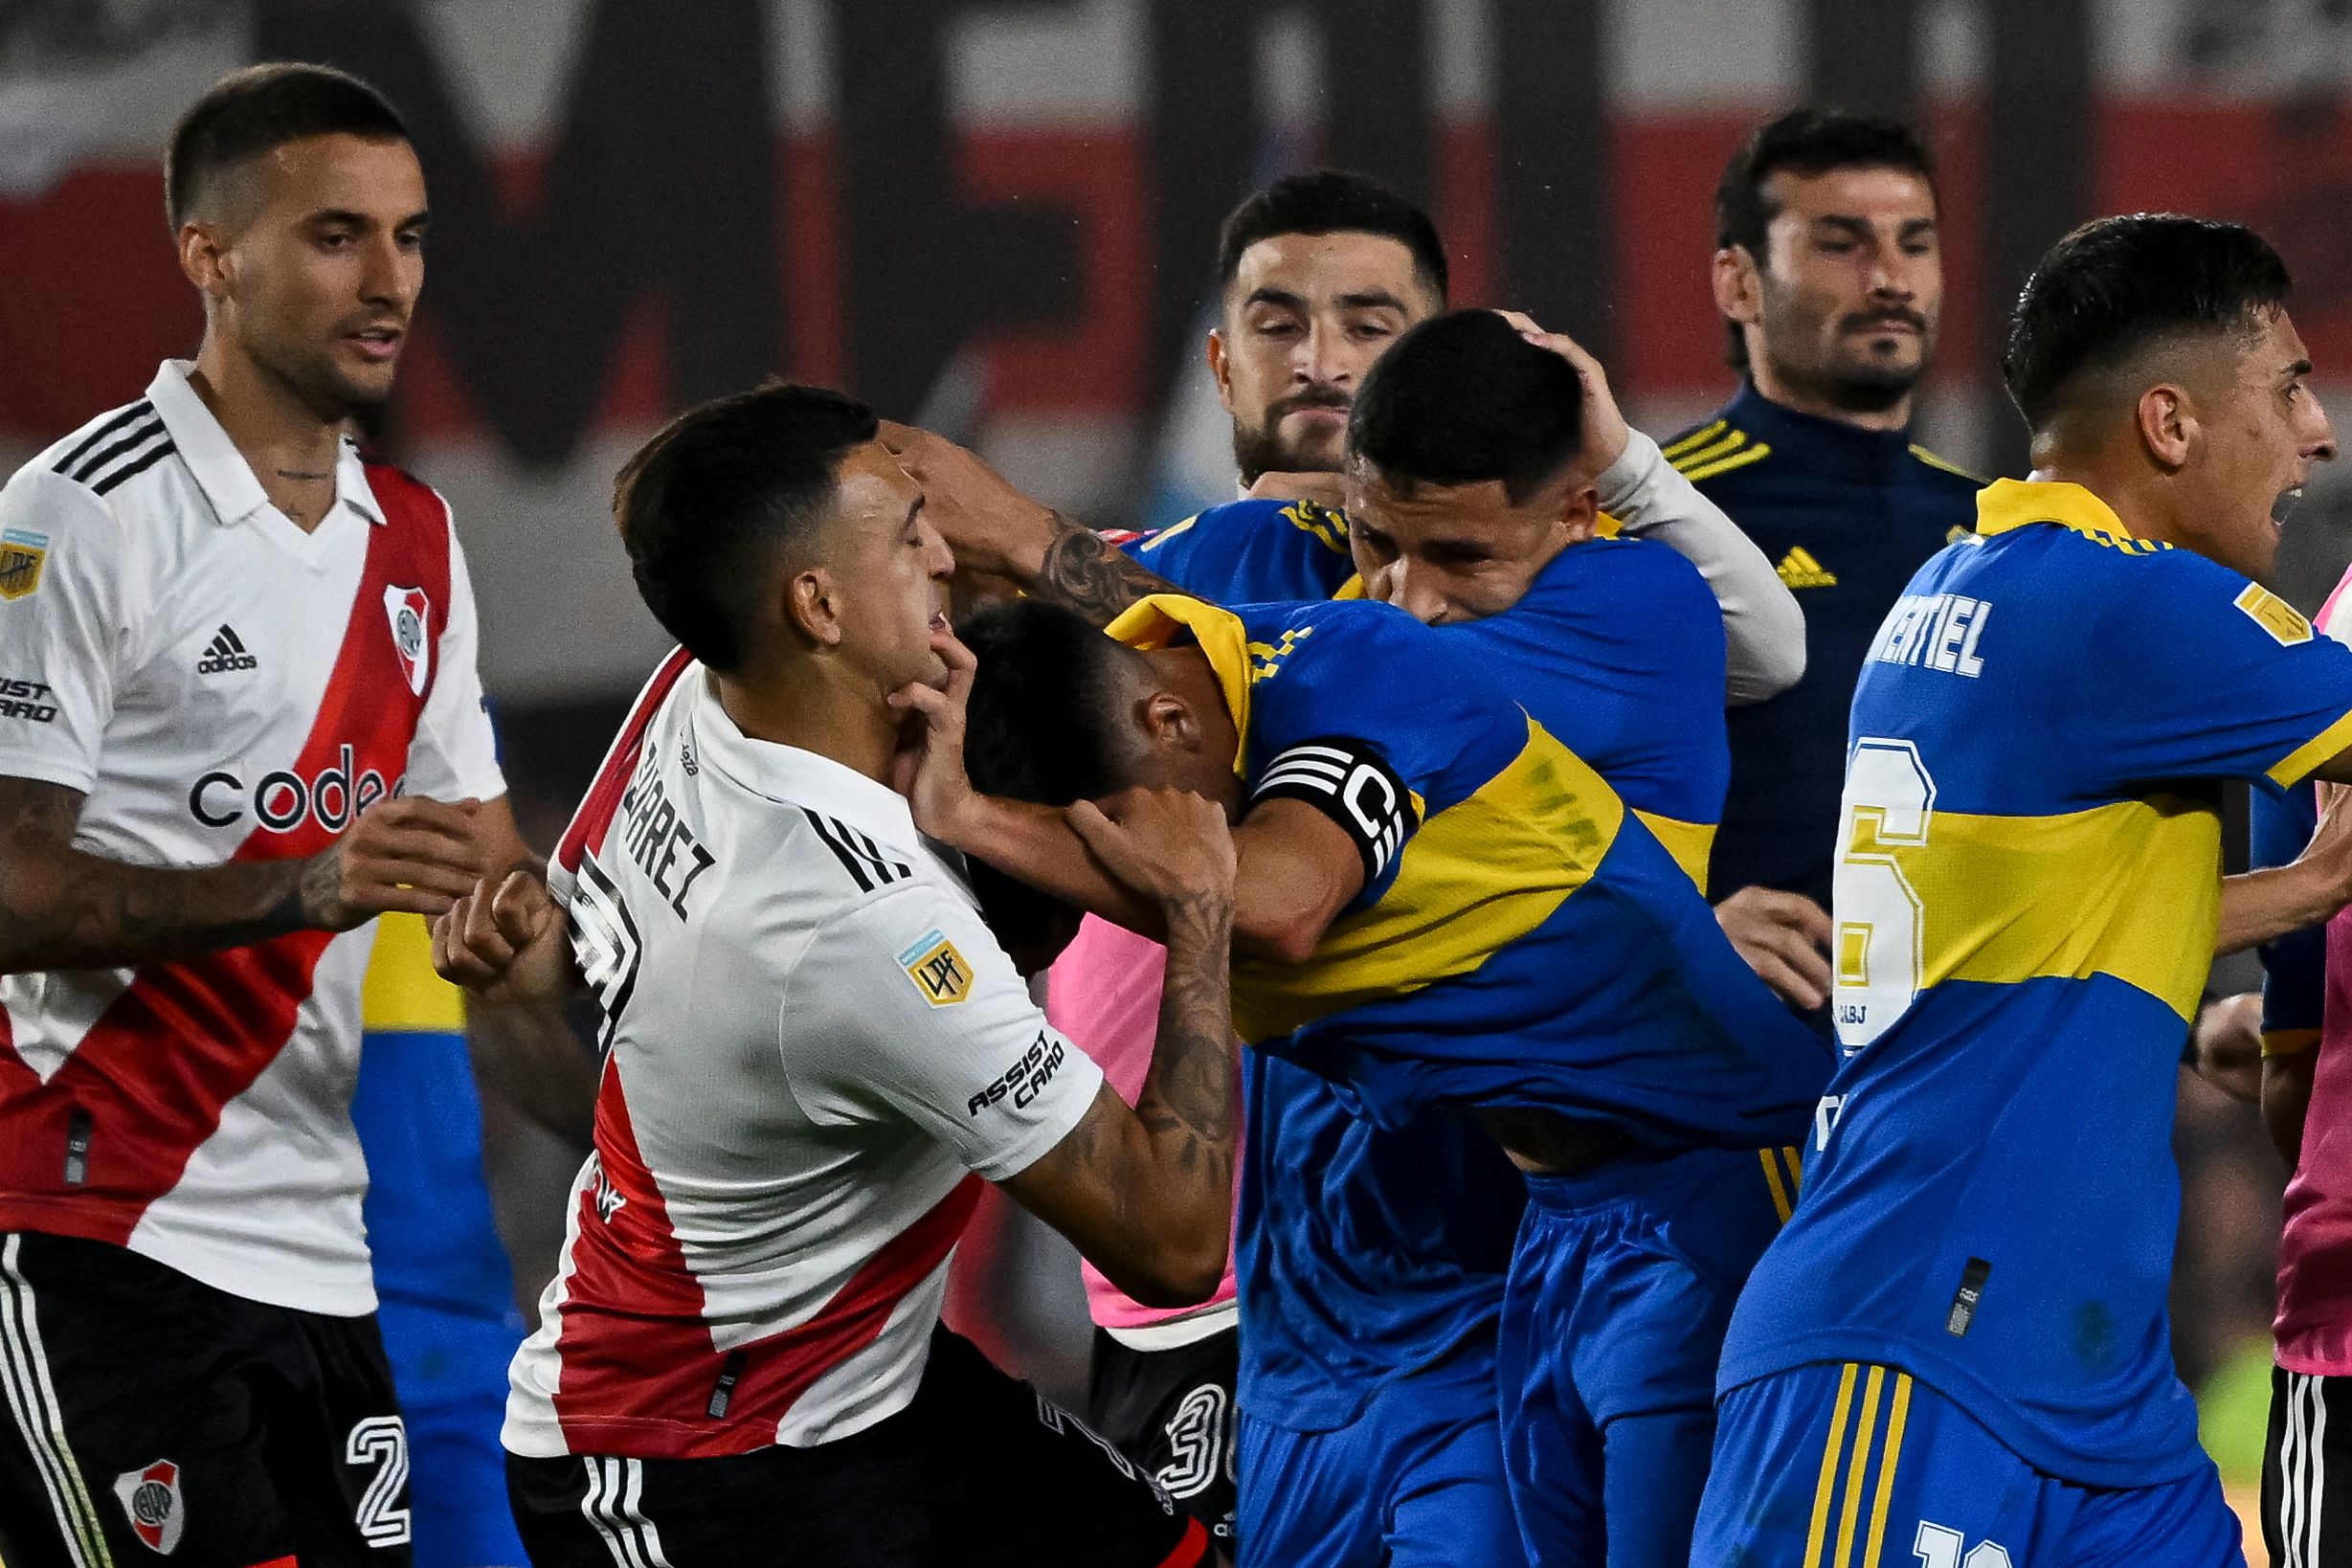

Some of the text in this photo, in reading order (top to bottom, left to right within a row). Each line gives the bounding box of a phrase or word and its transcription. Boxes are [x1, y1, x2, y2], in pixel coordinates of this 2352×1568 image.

[0, 677, 52, 700] IST
[198, 655, 257, 674] adidas
[189, 744, 406, 834] code
[1343, 764, 1396, 839] C
[968, 1029, 1048, 1117] ASSIST
[1015, 1041, 1064, 1109] CARD
[346, 1415, 411, 1548] 2
[1155, 1383, 1238, 1500] 3
